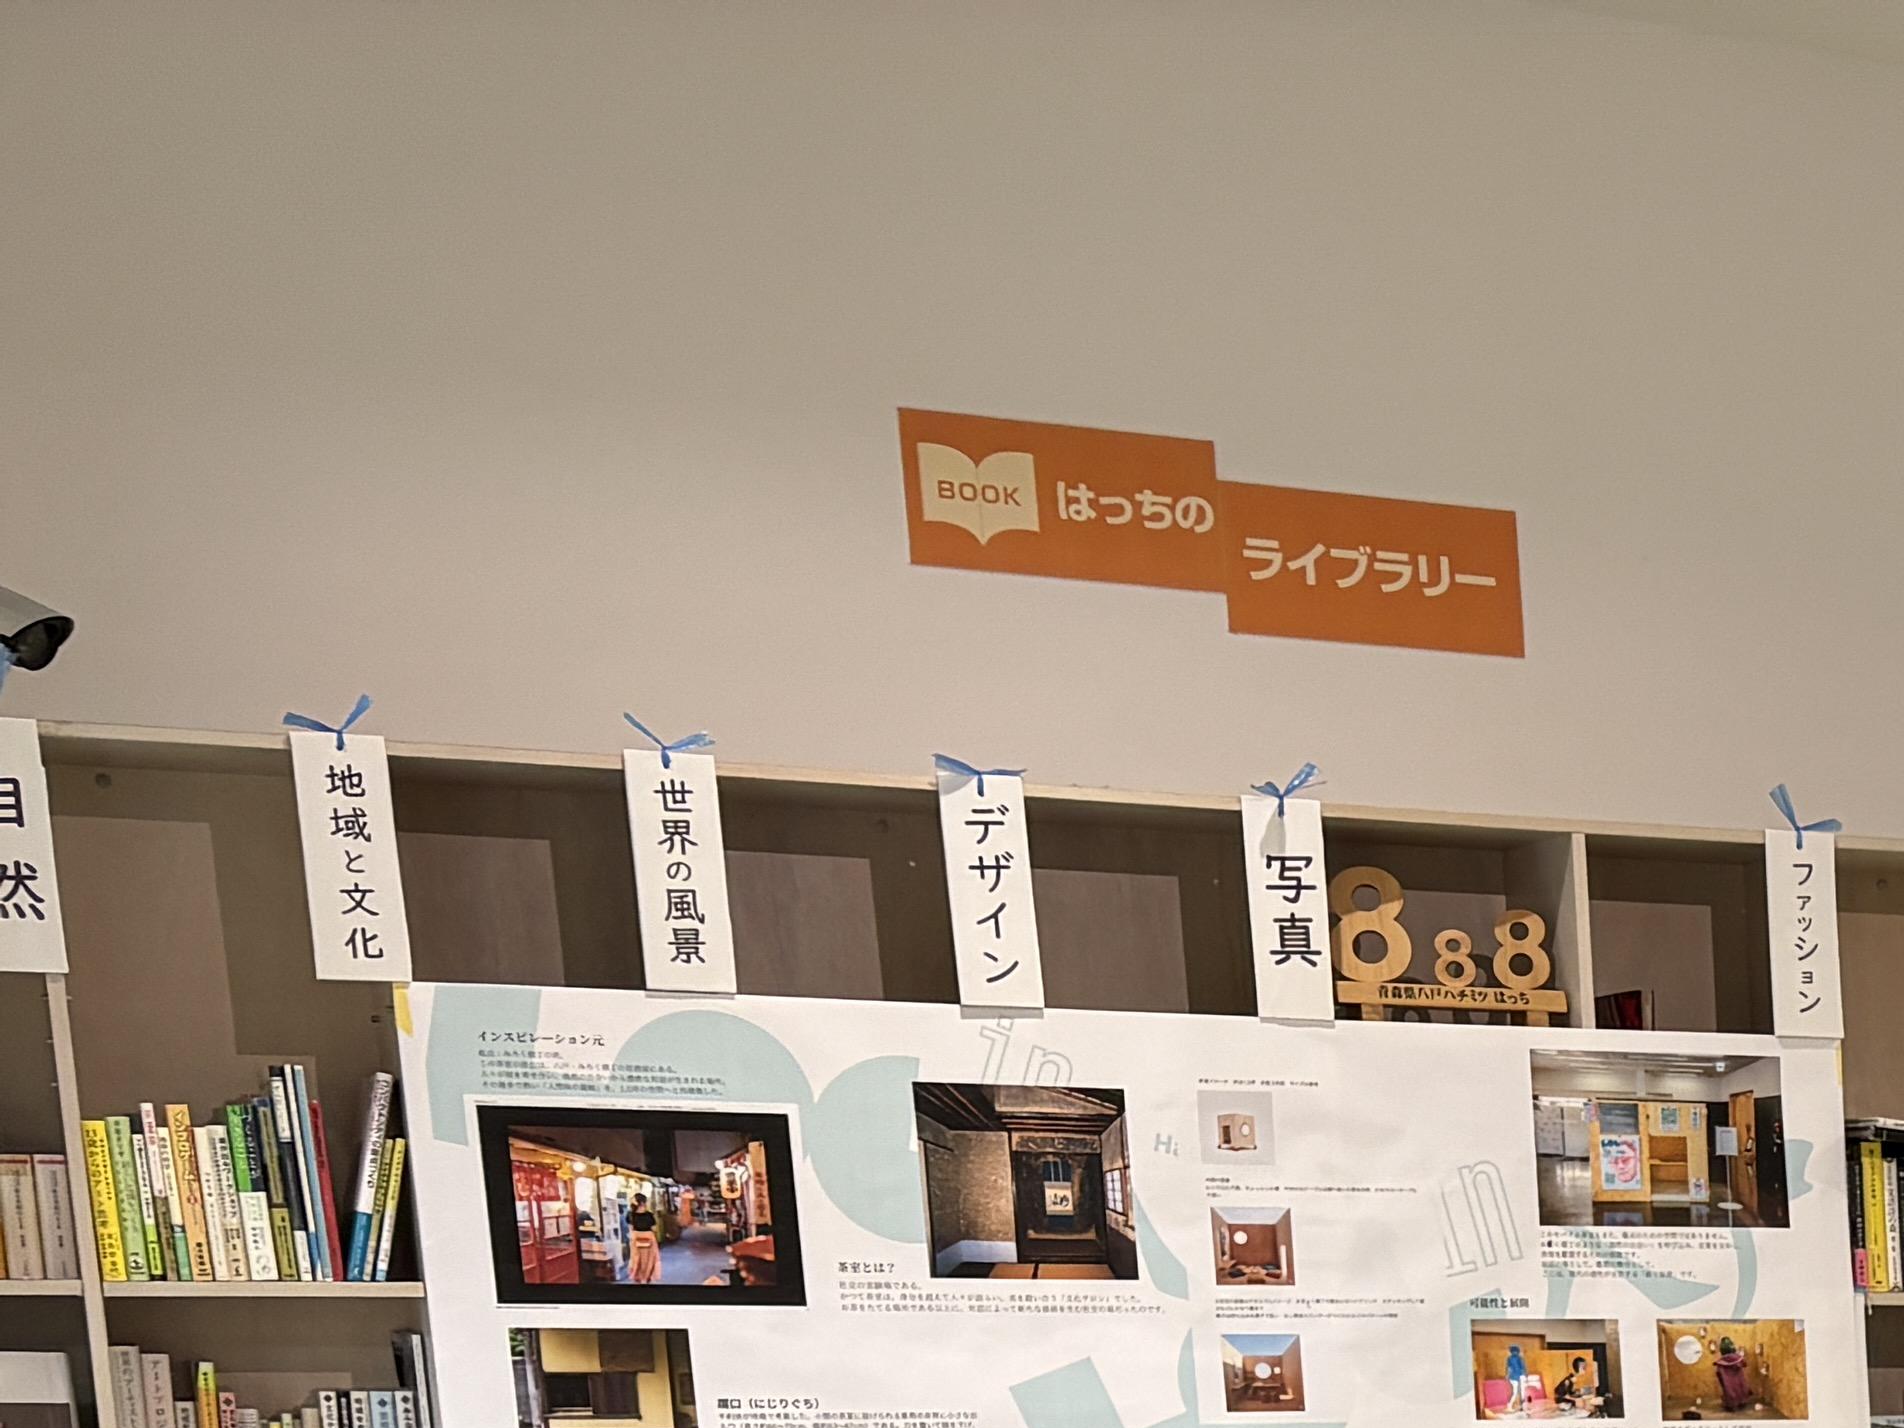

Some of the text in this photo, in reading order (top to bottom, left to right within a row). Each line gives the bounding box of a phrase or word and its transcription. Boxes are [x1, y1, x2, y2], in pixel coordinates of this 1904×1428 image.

[937, 479, 1021, 507] BOOK
[1056, 480, 1215, 533] はっちの
[1242, 537, 1498, 598] ライブラリー
[323, 763, 386, 961] 地域と文化
[653, 778, 708, 965] 世界の風景
[963, 804, 1021, 983] デザイン
[1263, 853, 1325, 970] 写真
[1792, 862, 1823, 1015] ファッション
